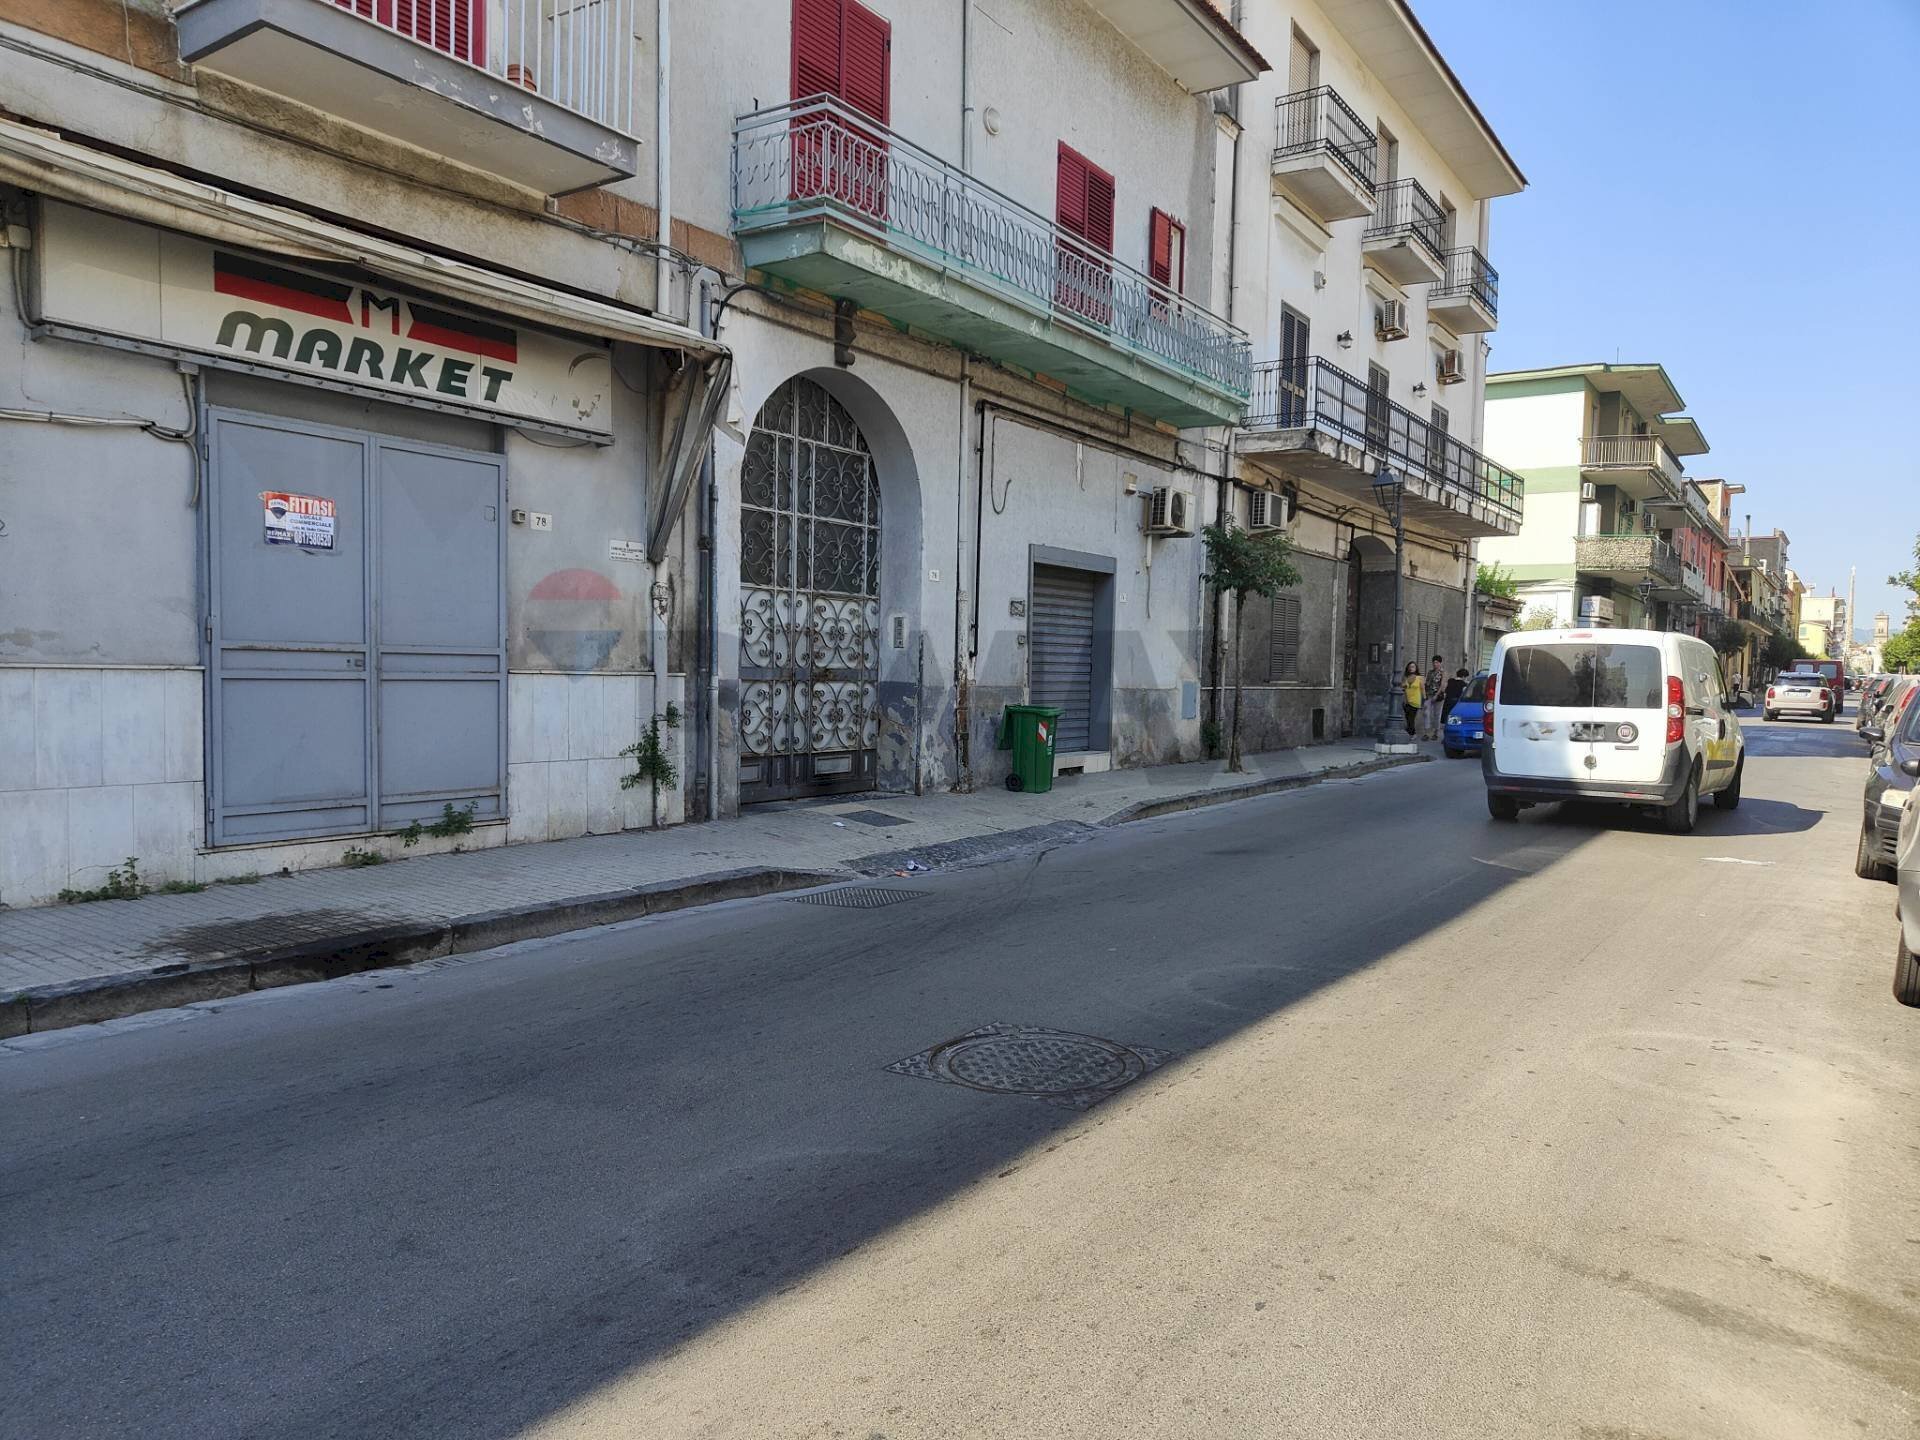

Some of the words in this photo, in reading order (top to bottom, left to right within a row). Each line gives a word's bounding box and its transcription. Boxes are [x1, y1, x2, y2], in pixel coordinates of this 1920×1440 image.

[216, 310, 513, 402] MARKET
[289, 496, 333, 516] FITTASI
[536, 516, 547, 527] 78
